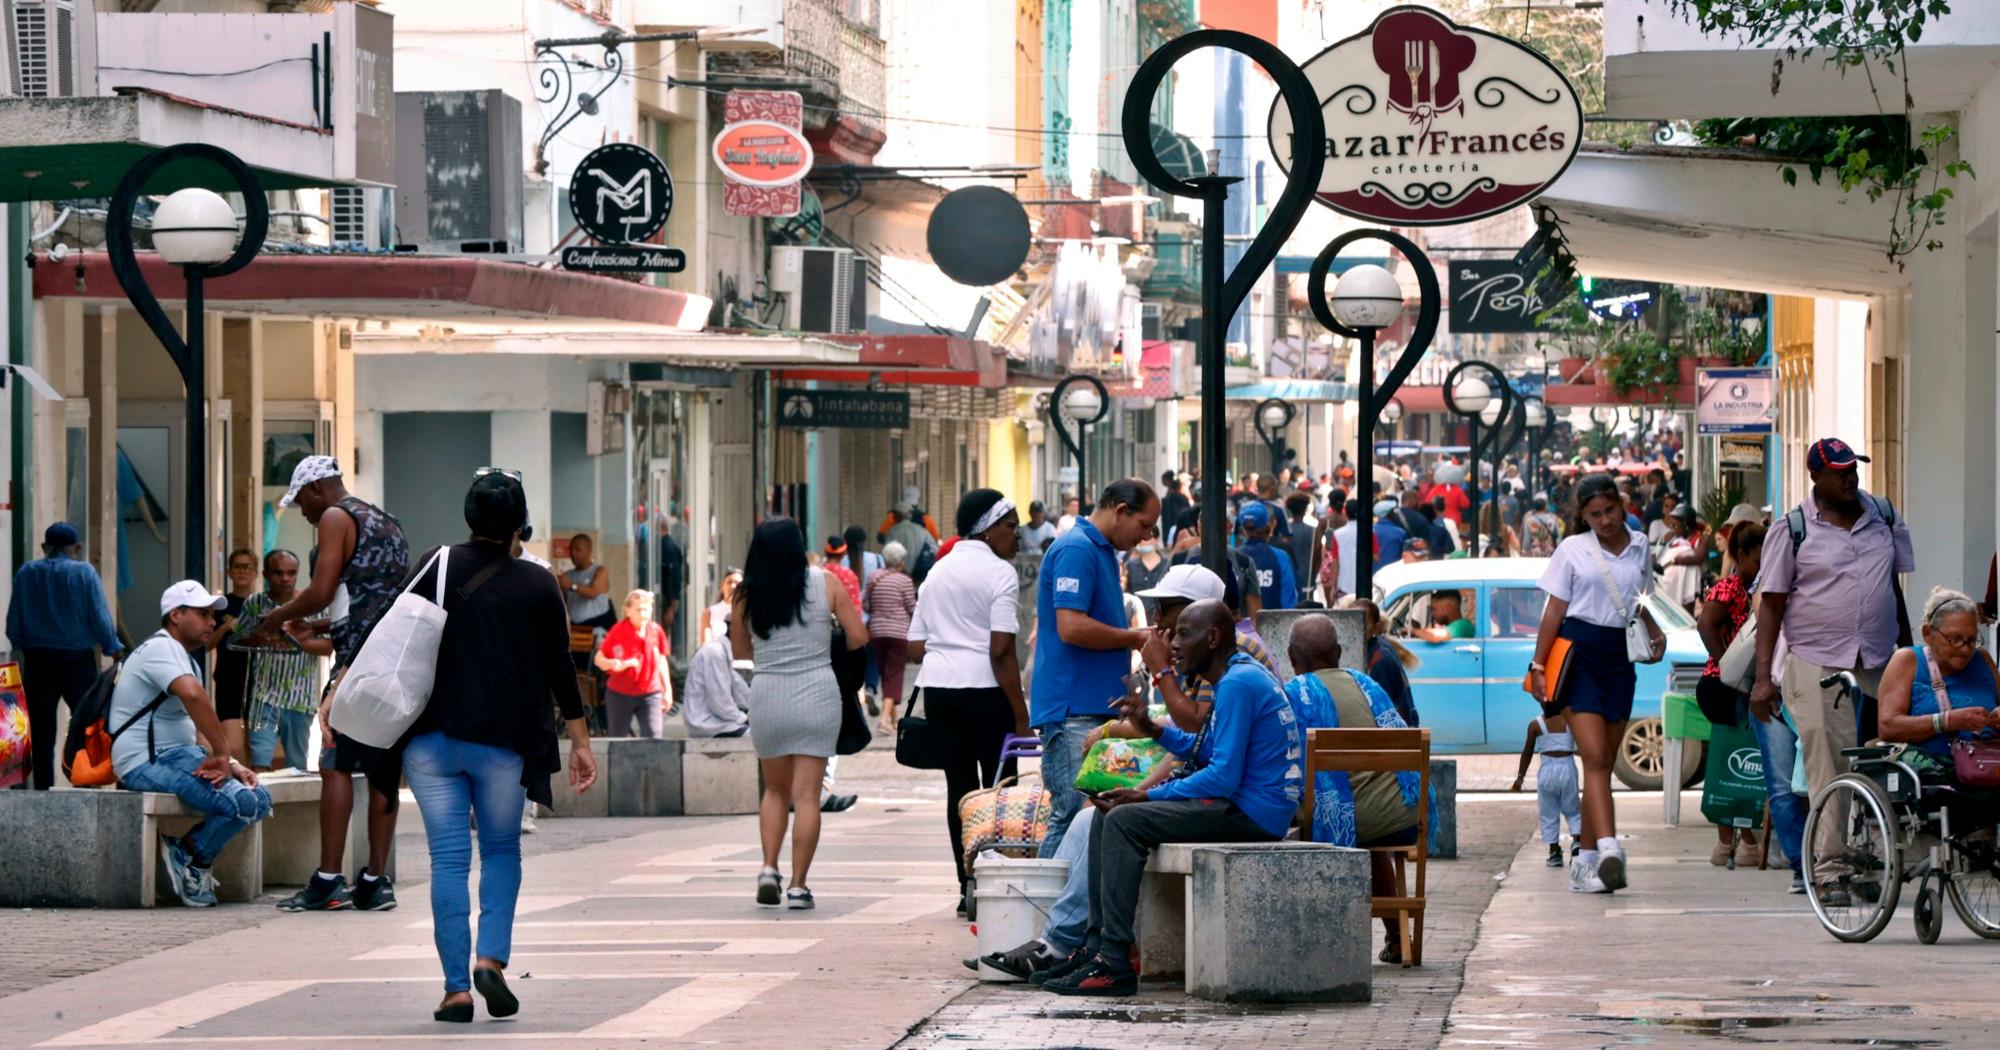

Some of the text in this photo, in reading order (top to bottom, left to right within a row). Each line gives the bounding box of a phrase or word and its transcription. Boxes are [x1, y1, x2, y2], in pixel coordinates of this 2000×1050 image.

[1286, 124, 1565, 160] azar Francés
[1372, 162, 1480, 175] cafetería
[567, 250, 679, 268] Confecciones Mima
[1461, 269, 1480, 281] Bar
[818, 396, 903, 413] Tintahabana
[1714, 402, 1763, 410] LA INDUSTRIA
[1731, 752, 1764, 773] Vima
